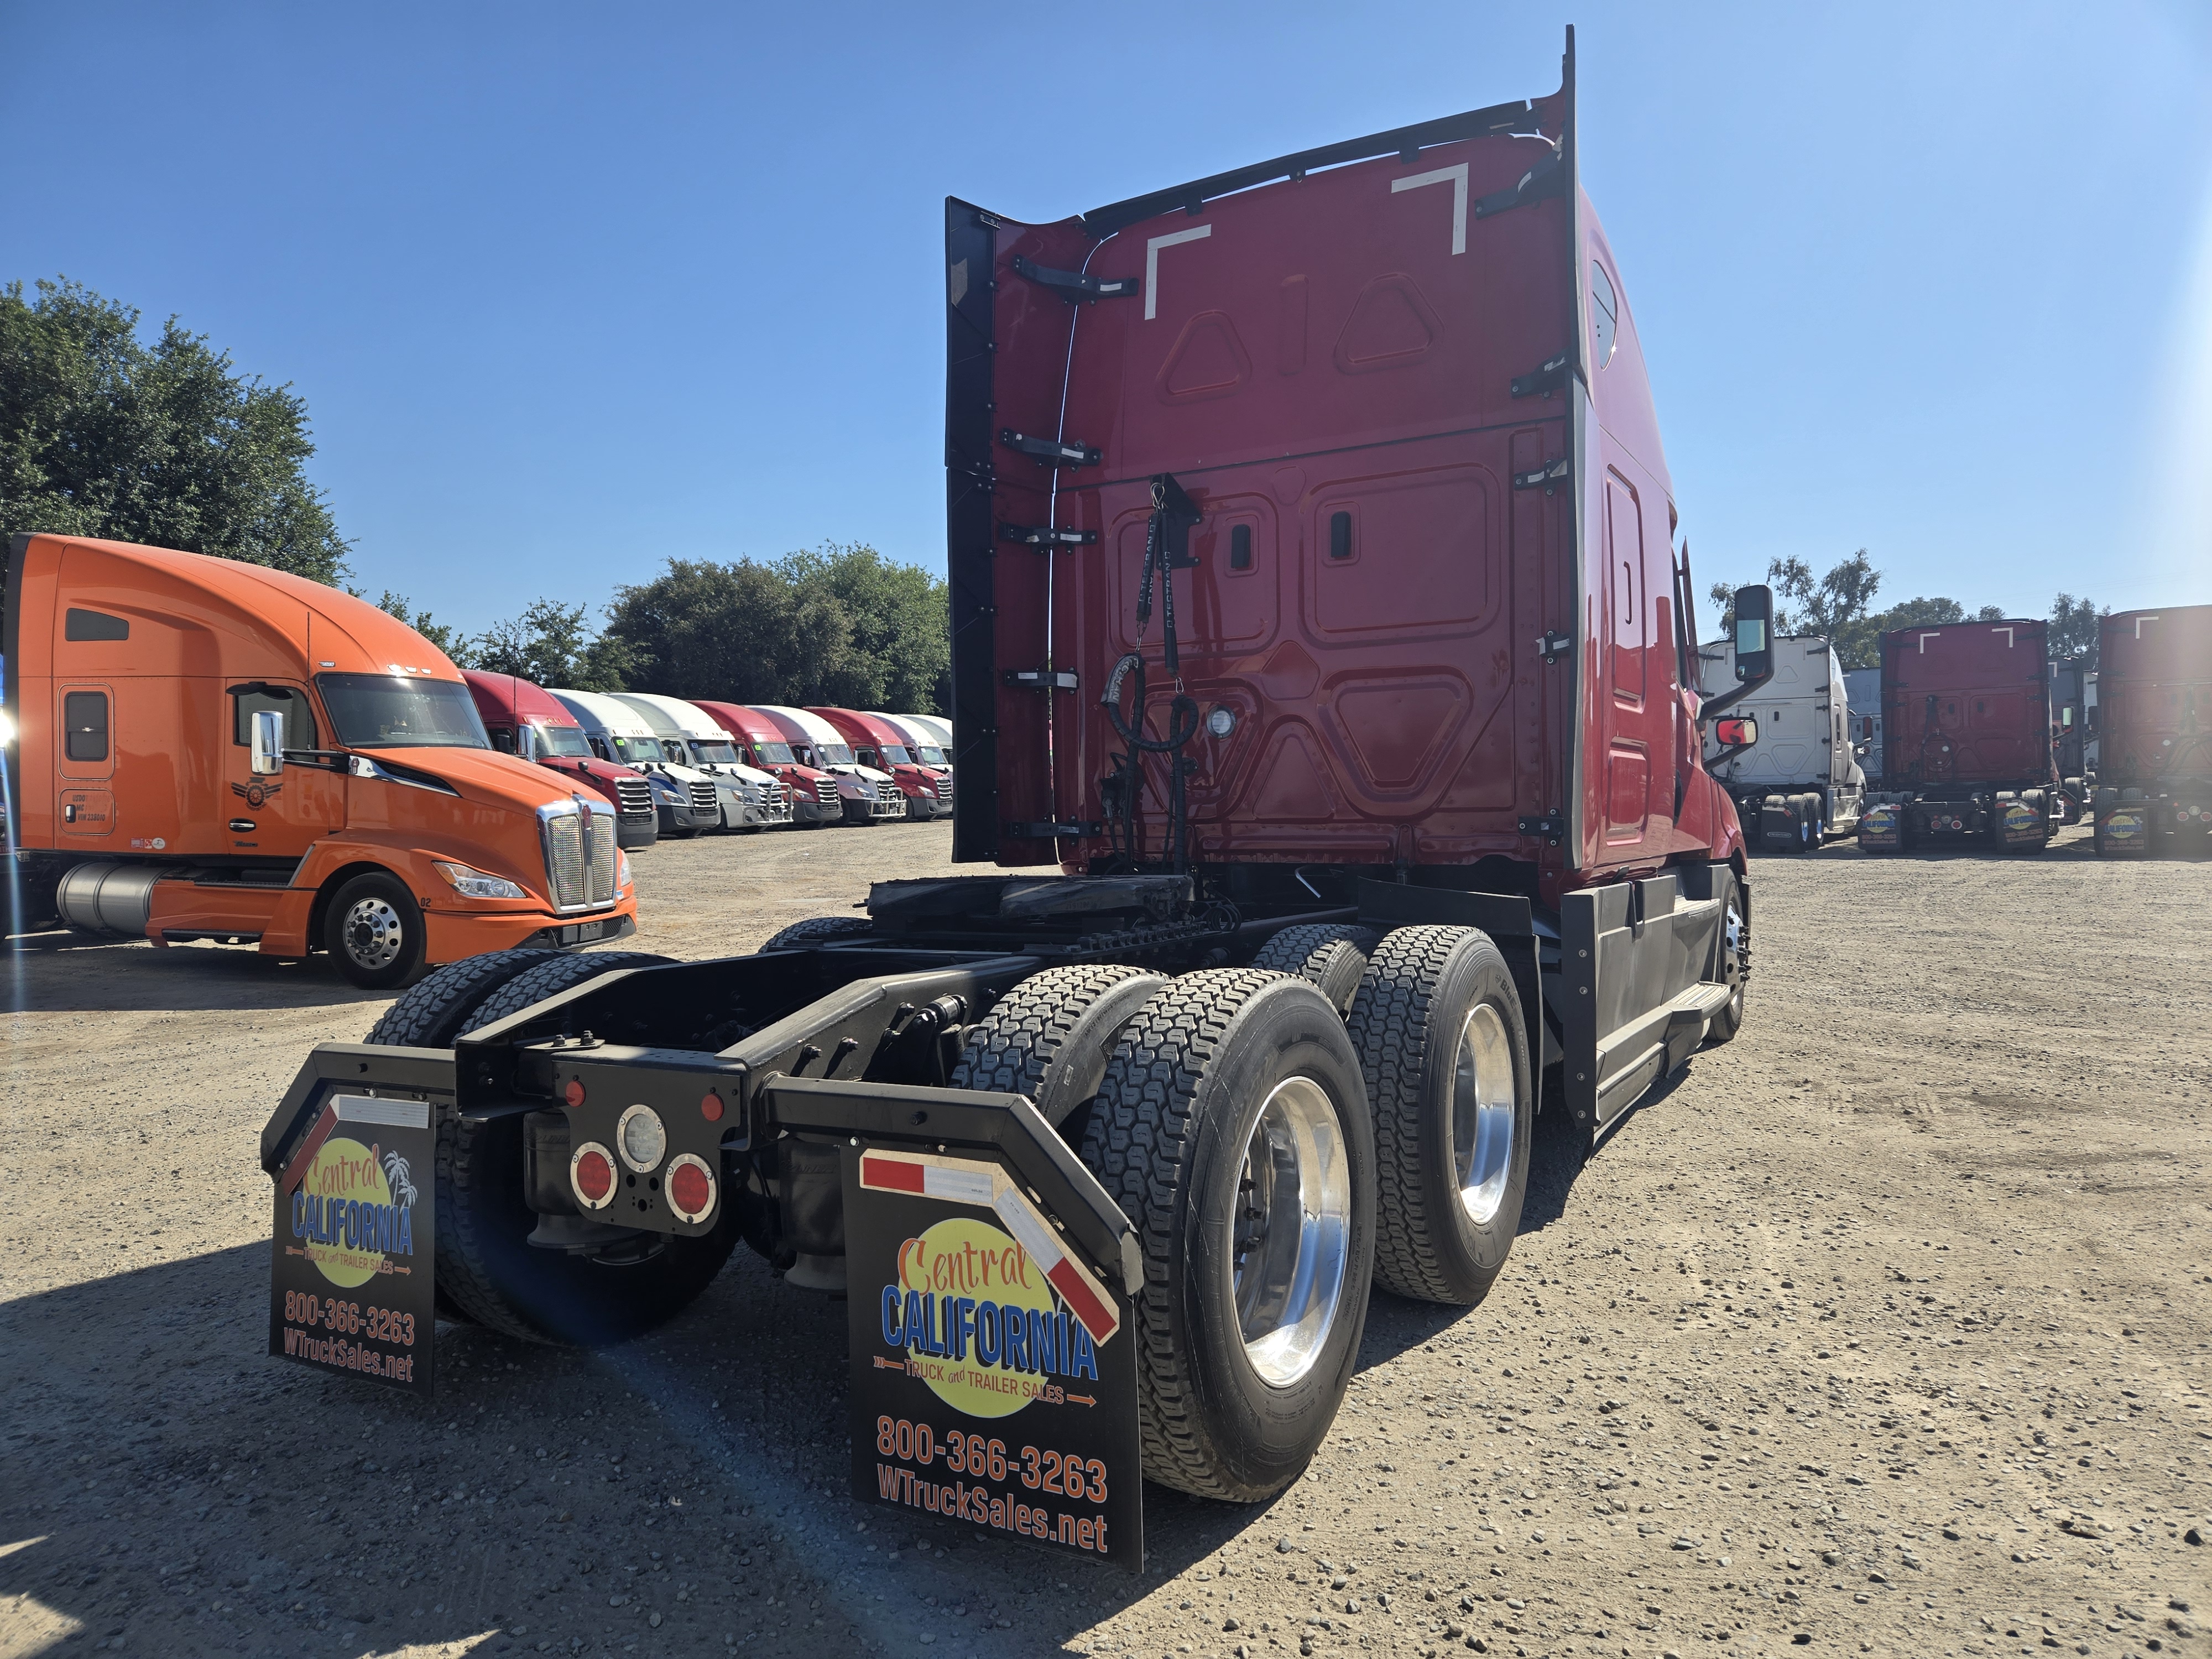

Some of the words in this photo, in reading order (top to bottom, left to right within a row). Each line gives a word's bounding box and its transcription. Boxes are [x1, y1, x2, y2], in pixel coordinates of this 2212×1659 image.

[421, 897, 431, 907] 02
[304, 1143, 380, 1200] Central
[292, 1190, 413, 1256] CALIFORNIA
[304, 1246, 327, 1264] TRUCK
[328, 1249, 339, 1265] and
[340, 1253, 368, 1271] TRAILER
[370, 1258, 394, 1275] SALES
[898, 1237, 1033, 1296] Central
[285, 1290, 415, 1346] 800-366-3263
[881, 1285, 1099, 1381] CALIFORNIA
[284, 1327, 414, 1383] WTruckSales.net
[904, 1358, 944, 1383] TRUCK
[948, 1364, 966, 1384] and
[968, 1371, 1018, 1397] TRAILER
[1022, 1379, 1065, 1405] SALES
[877, 1415, 1107, 1504] 800-366-3263
[877, 1463, 1108, 1553] WTruckSales.net
